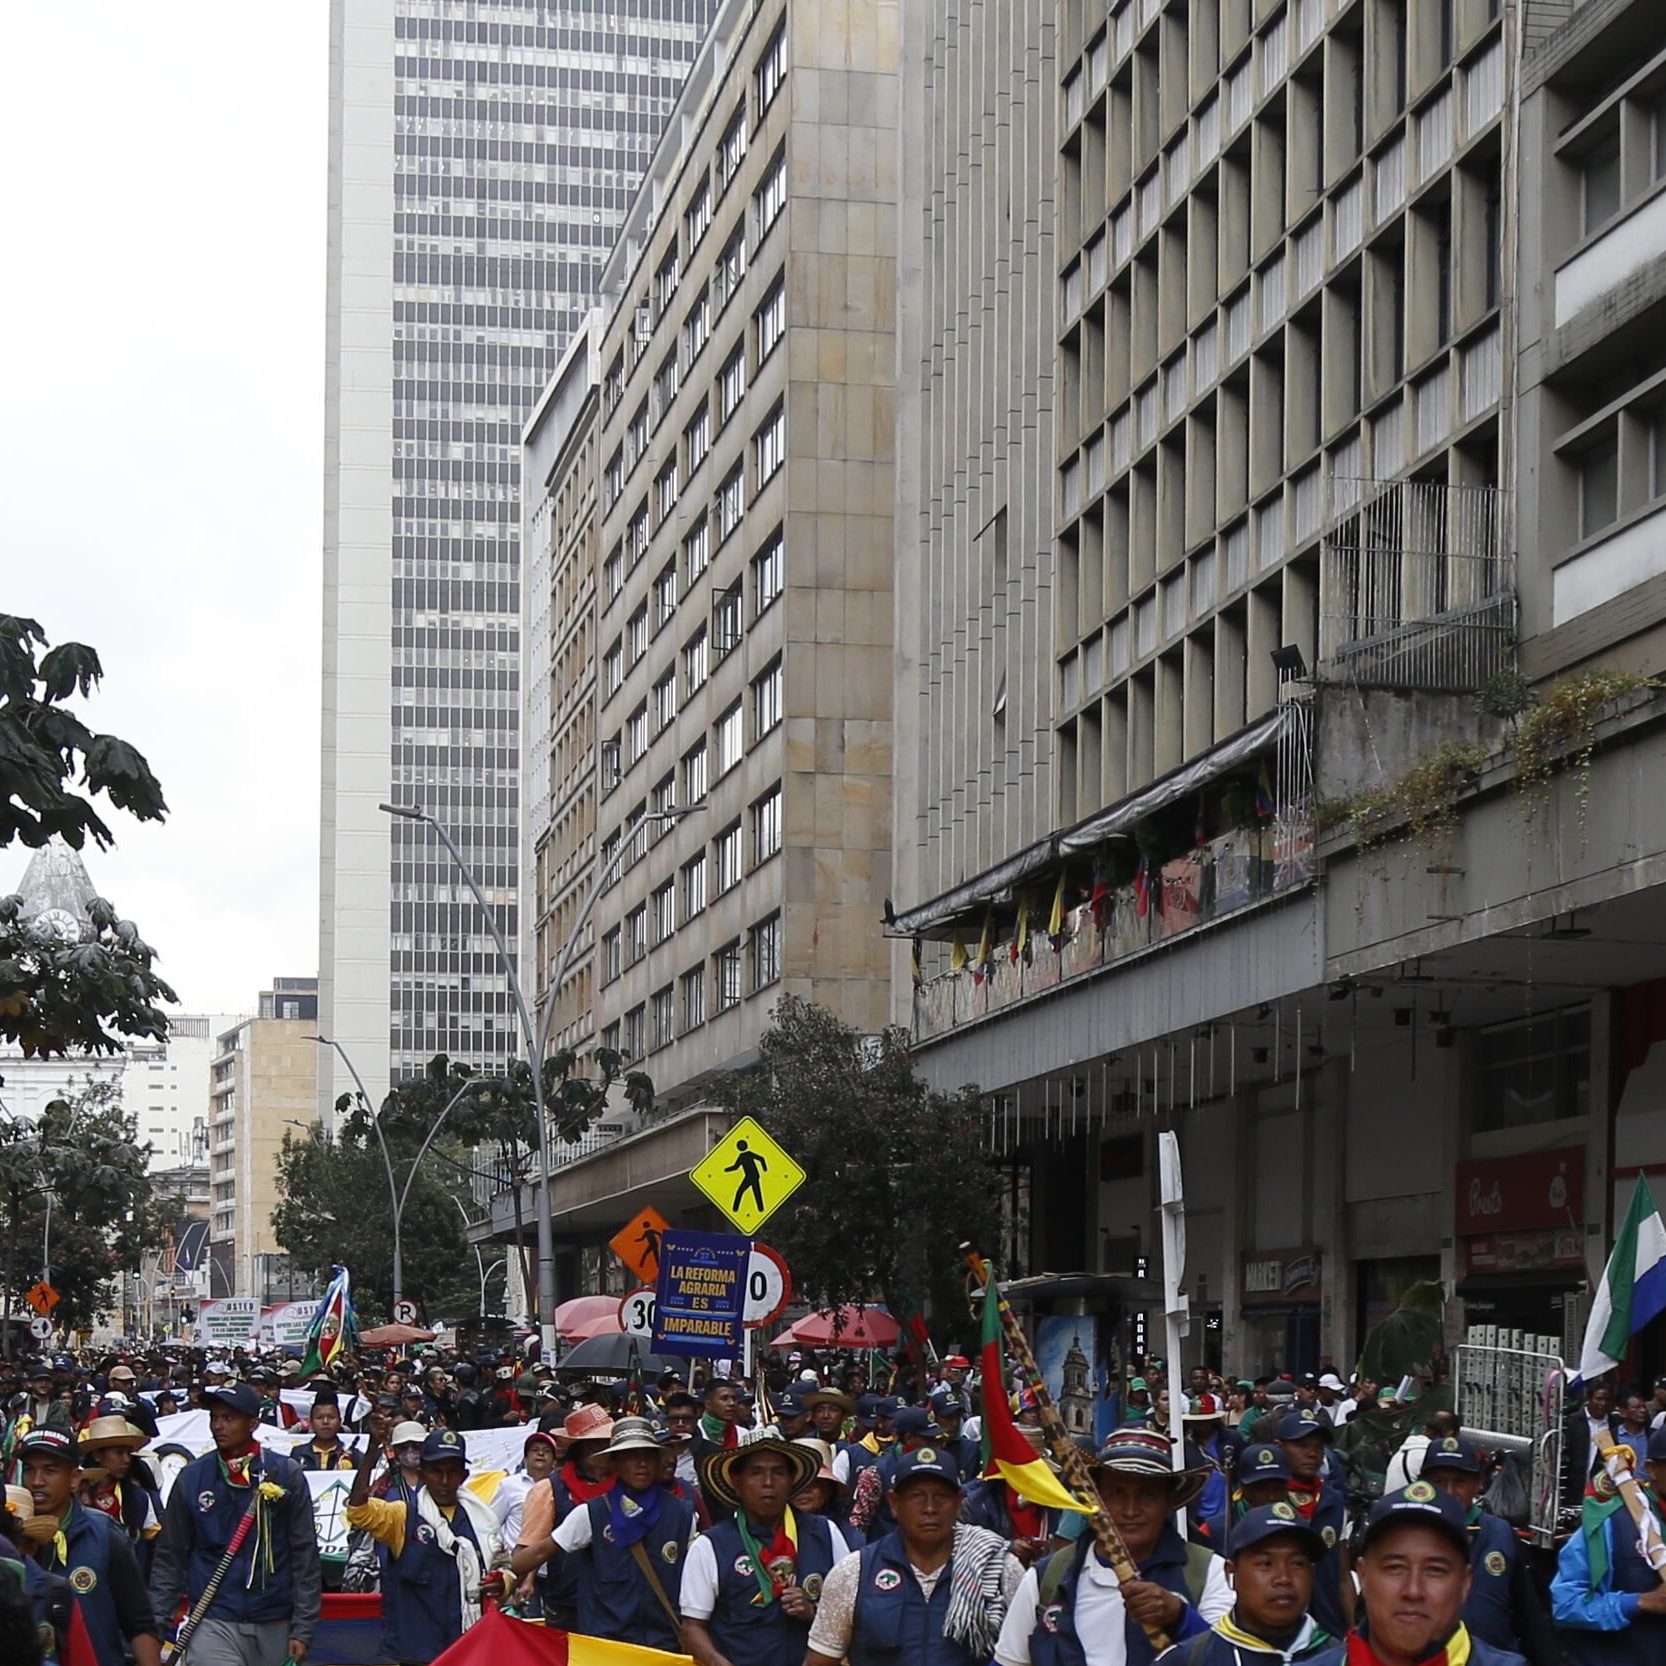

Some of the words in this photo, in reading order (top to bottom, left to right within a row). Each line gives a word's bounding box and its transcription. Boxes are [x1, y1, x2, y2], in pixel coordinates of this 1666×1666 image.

[670, 1265, 684, 1279] LA
[685, 1267, 735, 1283] REFORMA
[678, 1281, 726, 1296] AGRARIA
[227, 1303, 253, 1311] USTED
[692, 1297, 709, 1309] ES
[663, 1317, 732, 1336] IMPARABLE
